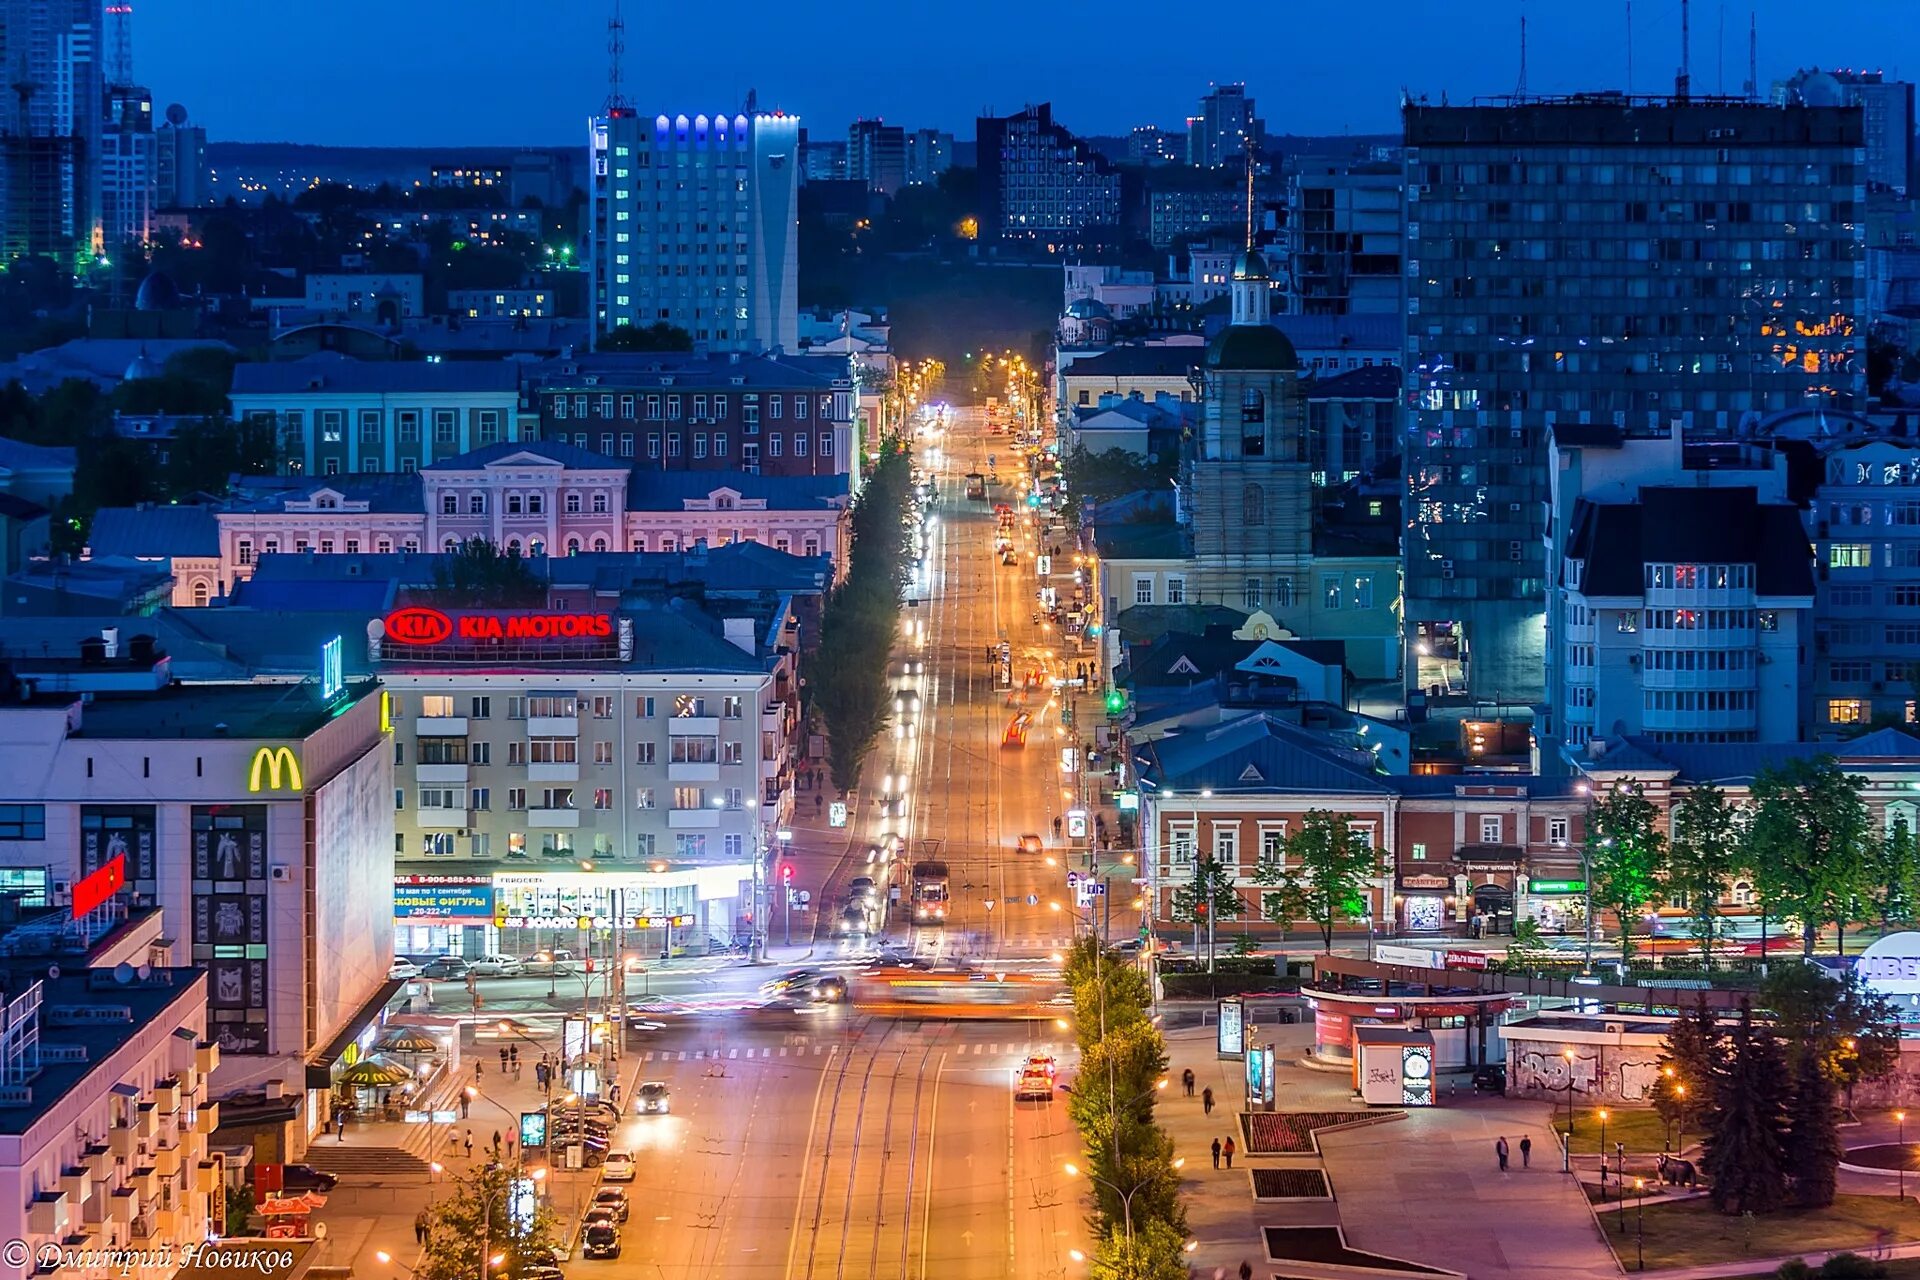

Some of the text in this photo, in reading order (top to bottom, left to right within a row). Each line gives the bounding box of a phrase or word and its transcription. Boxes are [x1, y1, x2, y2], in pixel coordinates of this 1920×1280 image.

[398, 615, 440, 637] KIA
[459, 614, 611, 638] KIA MOTORS
[438, 887, 472, 896] сентября
[439, 897, 486, 906] ФИГУРЫ
